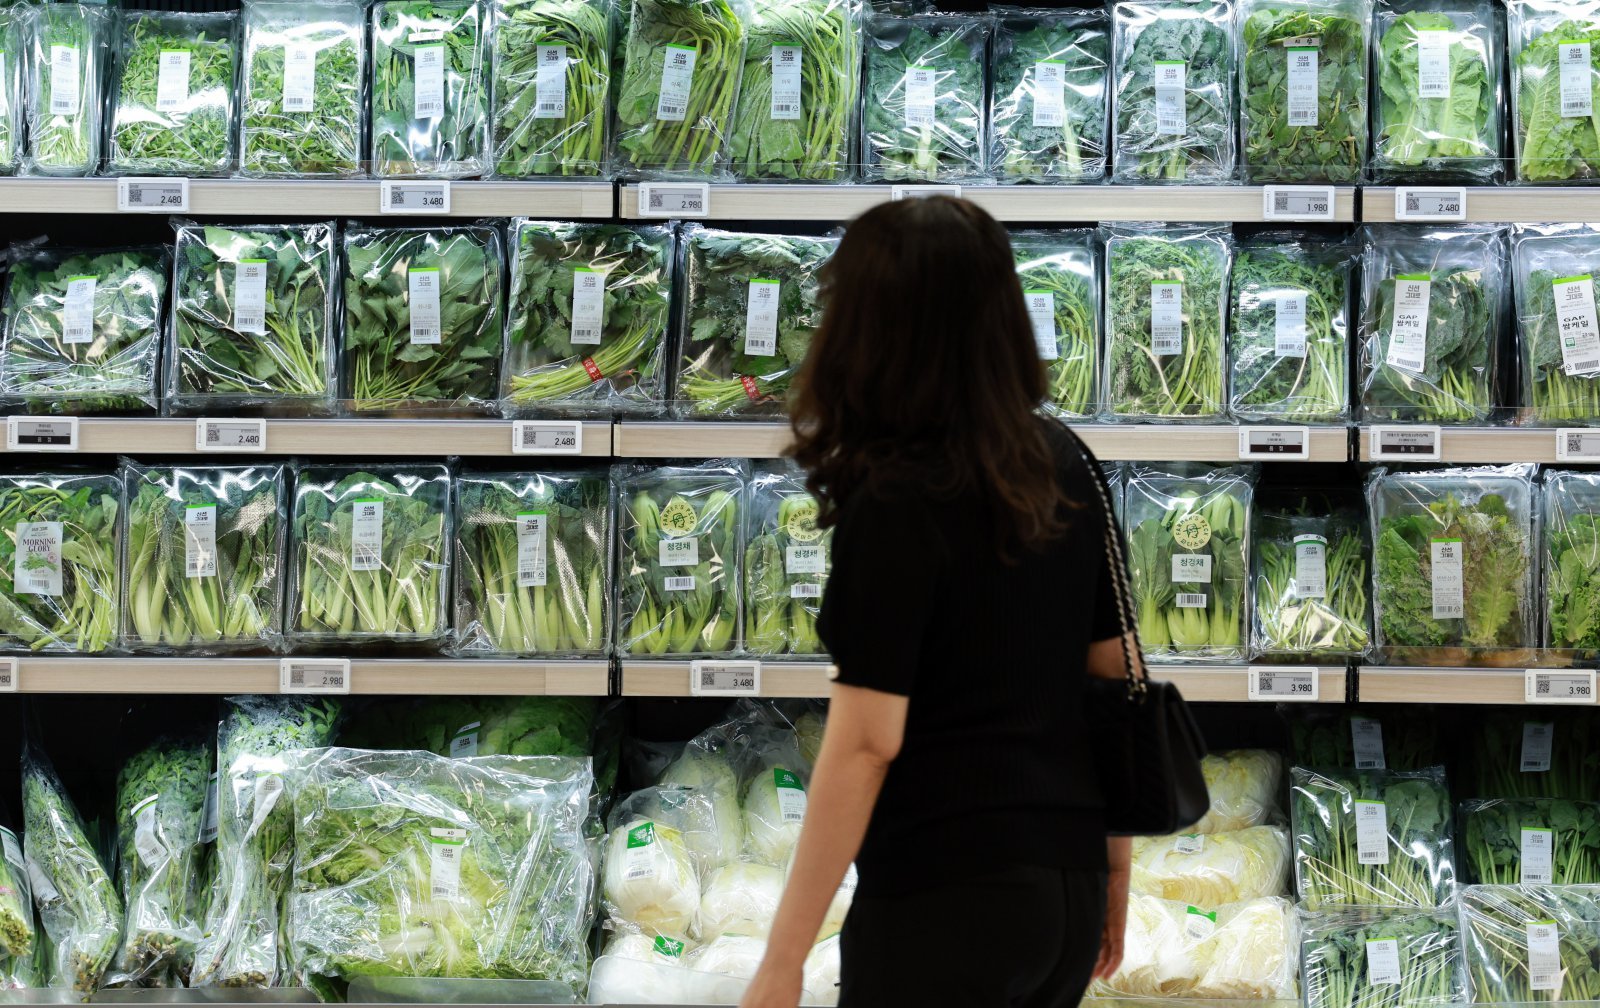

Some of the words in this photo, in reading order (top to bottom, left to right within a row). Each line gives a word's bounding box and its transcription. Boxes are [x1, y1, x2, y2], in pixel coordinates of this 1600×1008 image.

[161, 196, 182, 204] 2.480
[423, 197, 444, 205] 3.480
[682, 201, 702, 209] 2.980
[1307, 204, 1328, 212] 1.980
[1438, 204, 1459, 212] 2.480
[1567, 285, 1580, 294] 신선
[1565, 292, 1584, 300] 그대로
[1562, 320, 1589, 330] 쌈케일
[238, 435, 259, 443] 2.480
[555, 438, 576, 446] 2.480
[663, 504, 684, 526] FARMER'S
[685, 509, 694, 525] PICK
[1175, 516, 1199, 535] FARMER'S
[1201, 520, 1209, 536] PICK
[22, 537, 56, 546] MORNING
[668, 542, 691, 551] 청경채
[794, 550, 818, 558] 청경채
[1180, 558, 1204, 567] 청경채
[322, 677, 343, 685] 2.980
[733, 679, 754, 687] 3.480
[1291, 684, 1312, 692] 3.980
[1569, 687, 1590, 695] 3.980
